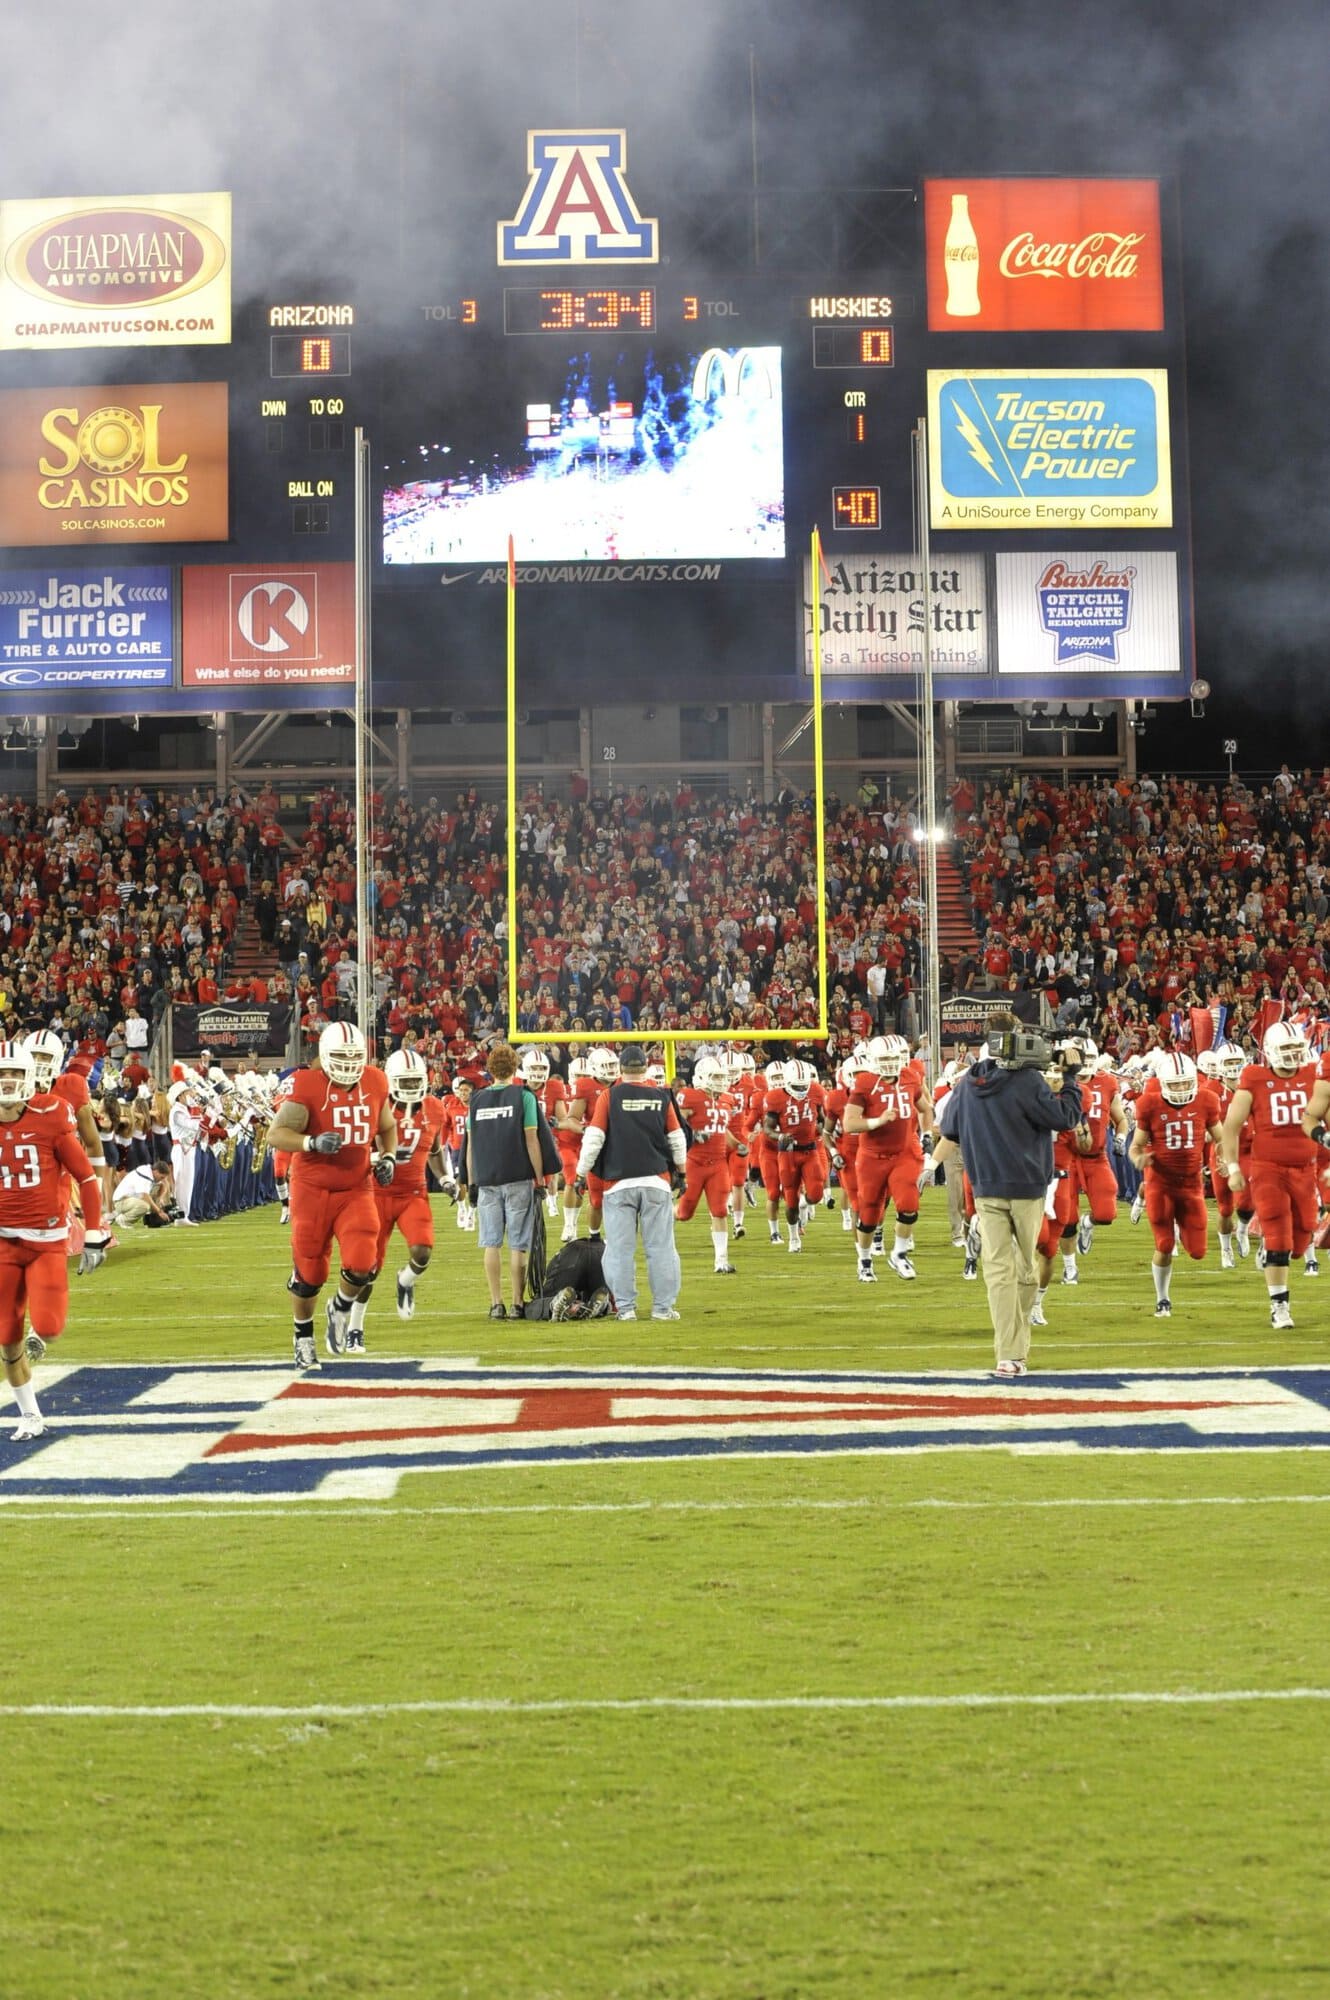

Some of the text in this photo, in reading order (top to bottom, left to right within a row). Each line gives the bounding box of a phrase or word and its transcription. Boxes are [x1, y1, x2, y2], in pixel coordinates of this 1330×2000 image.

[43, 231, 187, 271] CHAPMAN
[1000, 232, 1146, 279] Coca-Cola
[47, 269, 183, 287] AUTOMOTIVE
[270, 305, 353, 327] ARIZONA
[421, 306, 456, 321] TOL
[462, 301, 476, 322] 3
[541, 291, 651, 328] 3:34
[684, 297, 698, 319] 3
[704, 301, 739, 317] TOL
[810, 298, 892, 318] HUSKIES
[15, 318, 214, 336] CHAPMANTUCSON.COM
[303, 339, 330, 370] 0
[862, 331, 890, 362] 0
[262, 401, 287, 416] DWN
[310, 399, 344, 415] TO GO
[844, 391, 866, 407] QTR
[995, 392, 1105, 422] Tucson
[38, 404, 188, 478] SOL
[1006, 422, 1136, 450] Electric
[1021, 451, 1136, 479] Power
[38, 476, 189, 509] CASINOS
[288, 481, 333, 497] BALL ON
[837, 492, 876, 523] 40
[942, 504, 1159, 520] A UniSource Energy Company
[61, 518, 165, 531] SOLCASINOS.COM
[478, 564, 721, 585] ARZONAWILDCATS.COM
[824, 560, 961, 595] Arizona
[1040, 563, 1134, 588] Bashas'
[39, 576, 125, 609] Jack
[1047, 593, 1123, 606] OFFICIAL
[907, 599, 982, 634] Star
[1047, 606, 1123, 618] TAILGATE
[18, 608, 146, 639] Furrier
[1048, 619, 1123, 627] HEADQUARTERS
[4, 641, 161, 657] TIRE & AUTO CARE
[1061, 636, 1112, 647] ARIZONA
[841, 652, 851, 664] a
[857, 648, 922, 664] Tucson
[930, 647, 983, 666] thing.
[195, 665, 352, 680] What else do you need?
[603, 746, 616, 760] 28
[1224, 740, 1236, 753] 29
[943, 1003, 1012, 1012] AMERICAN FAMILY
[1080, 994, 1093, 1006] 32
[200, 1015, 269, 1024] AMERICAN FAMILY
[475, 1105, 513, 1121] ESPN
[621, 1099, 662, 1112] ESPN
[880, 1092, 911, 1119] 76
[1270, 1090, 1308, 1126] 62
[333, 1105, 370, 1146] 55
[704, 1108, 729, 1134] 33
[1165, 1120, 1195, 1150] 61
